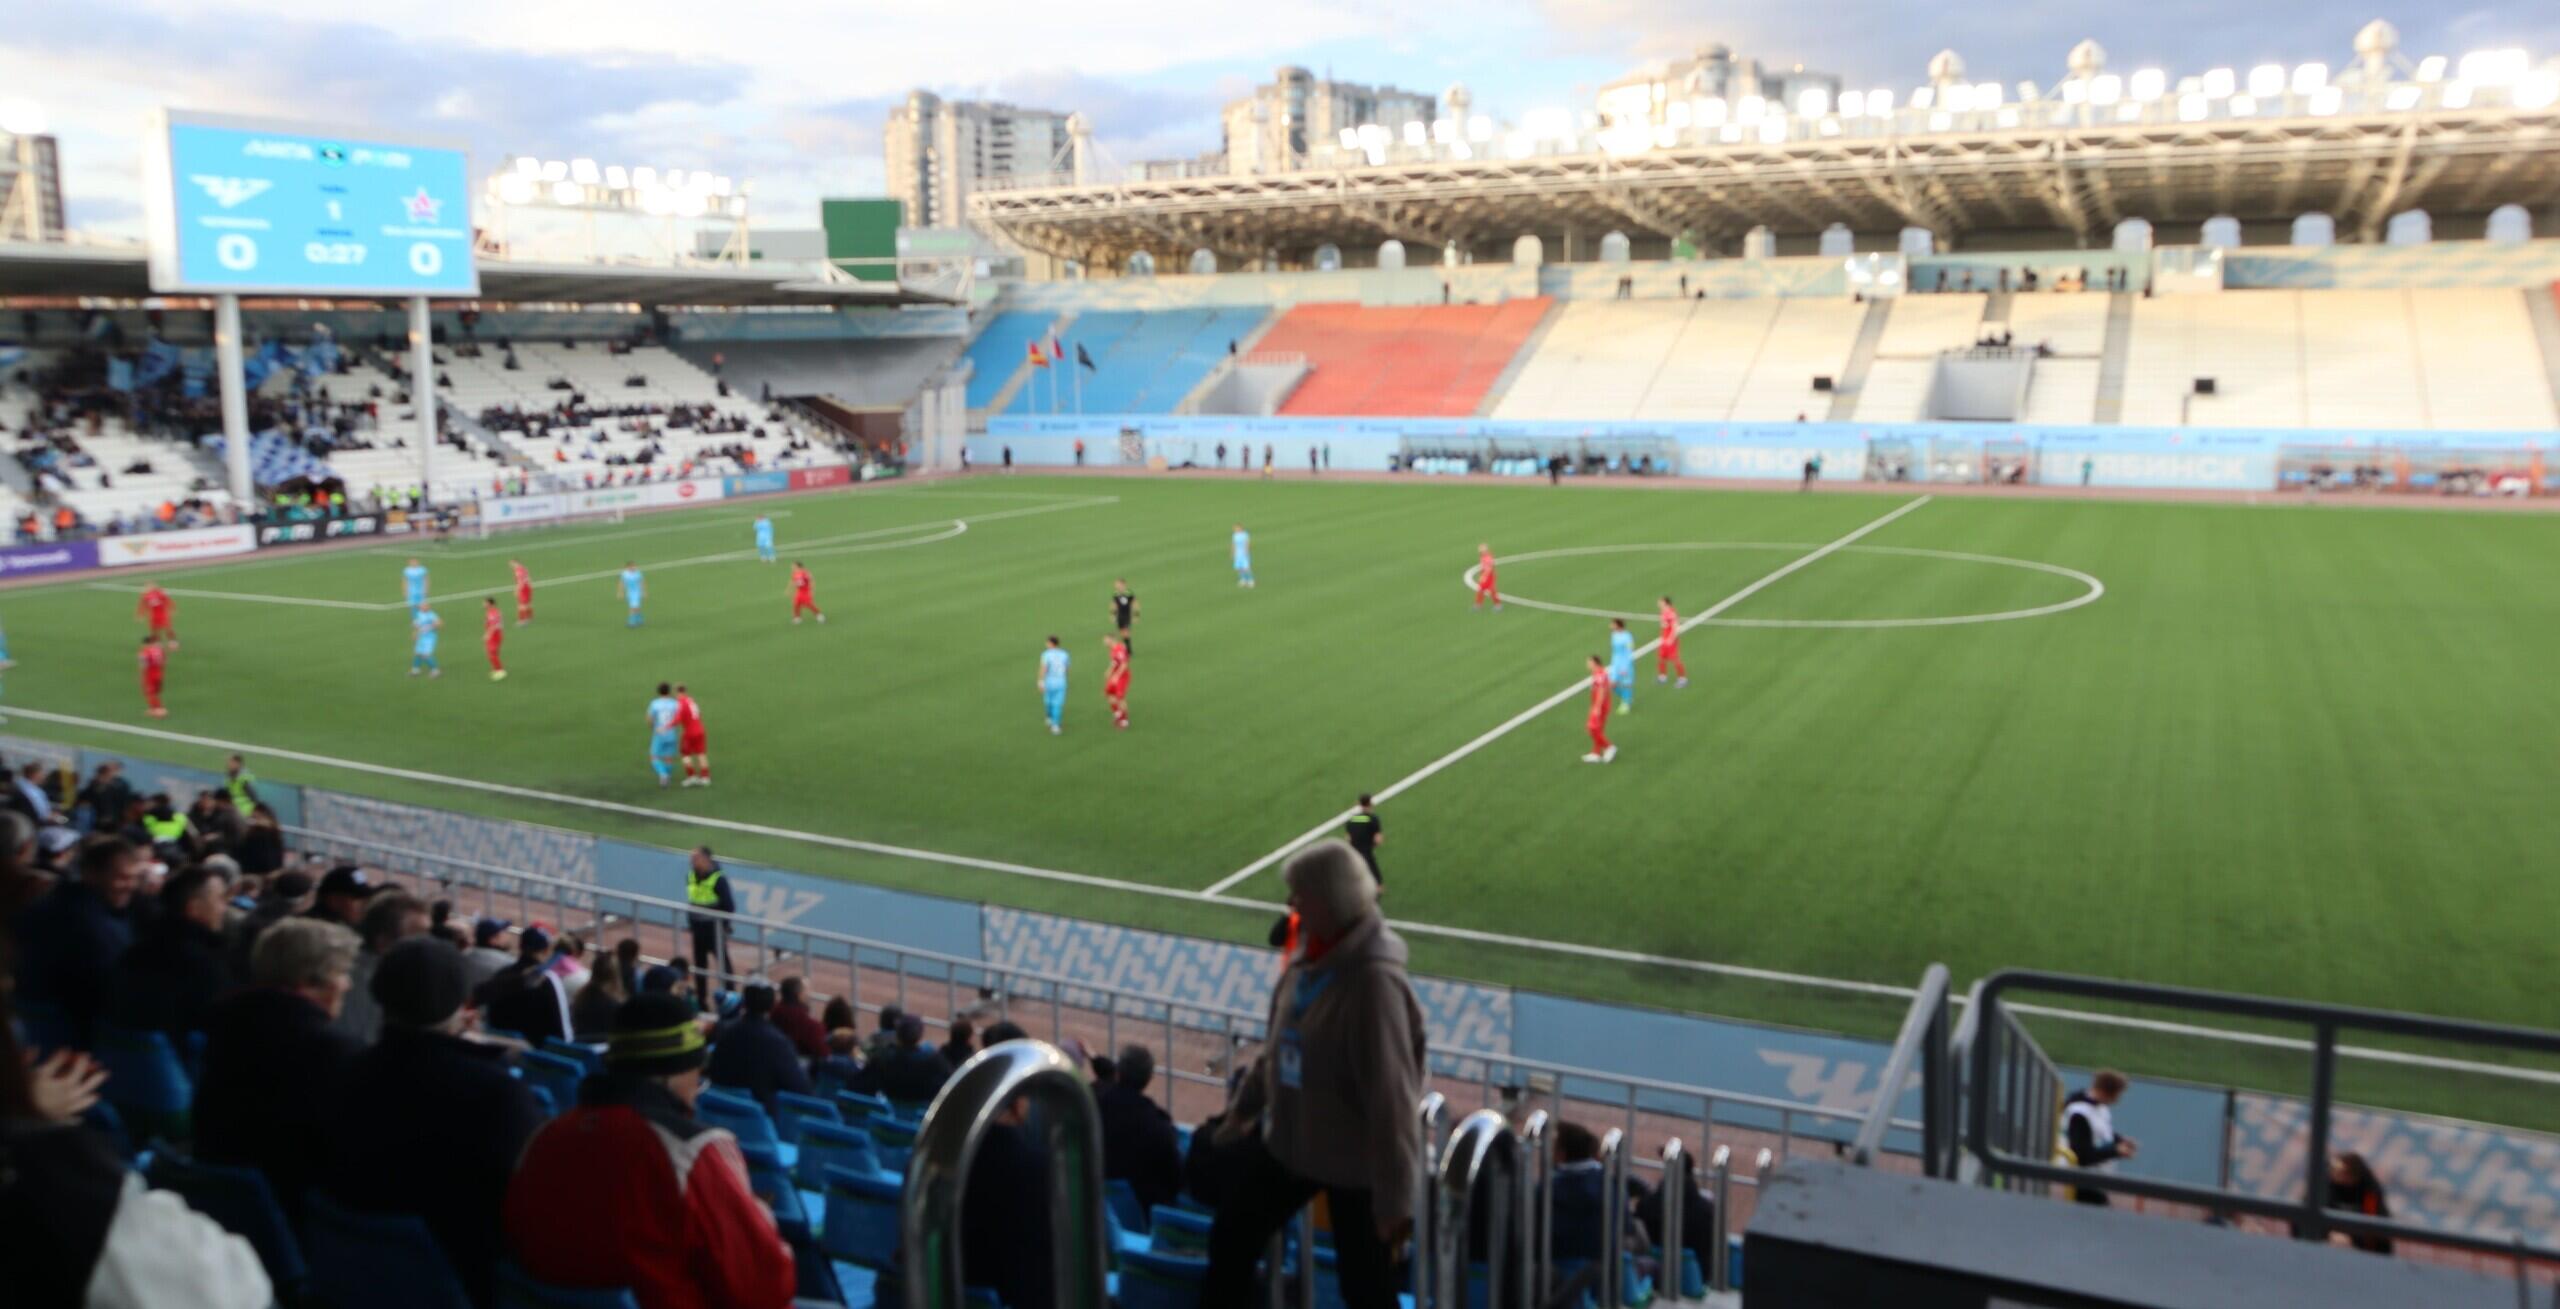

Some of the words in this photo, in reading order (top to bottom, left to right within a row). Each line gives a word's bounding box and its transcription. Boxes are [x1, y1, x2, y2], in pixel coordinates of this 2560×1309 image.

[326, 198, 342, 222] 1
[216, 233, 258, 271] 0
[408, 242, 443, 276] 0
